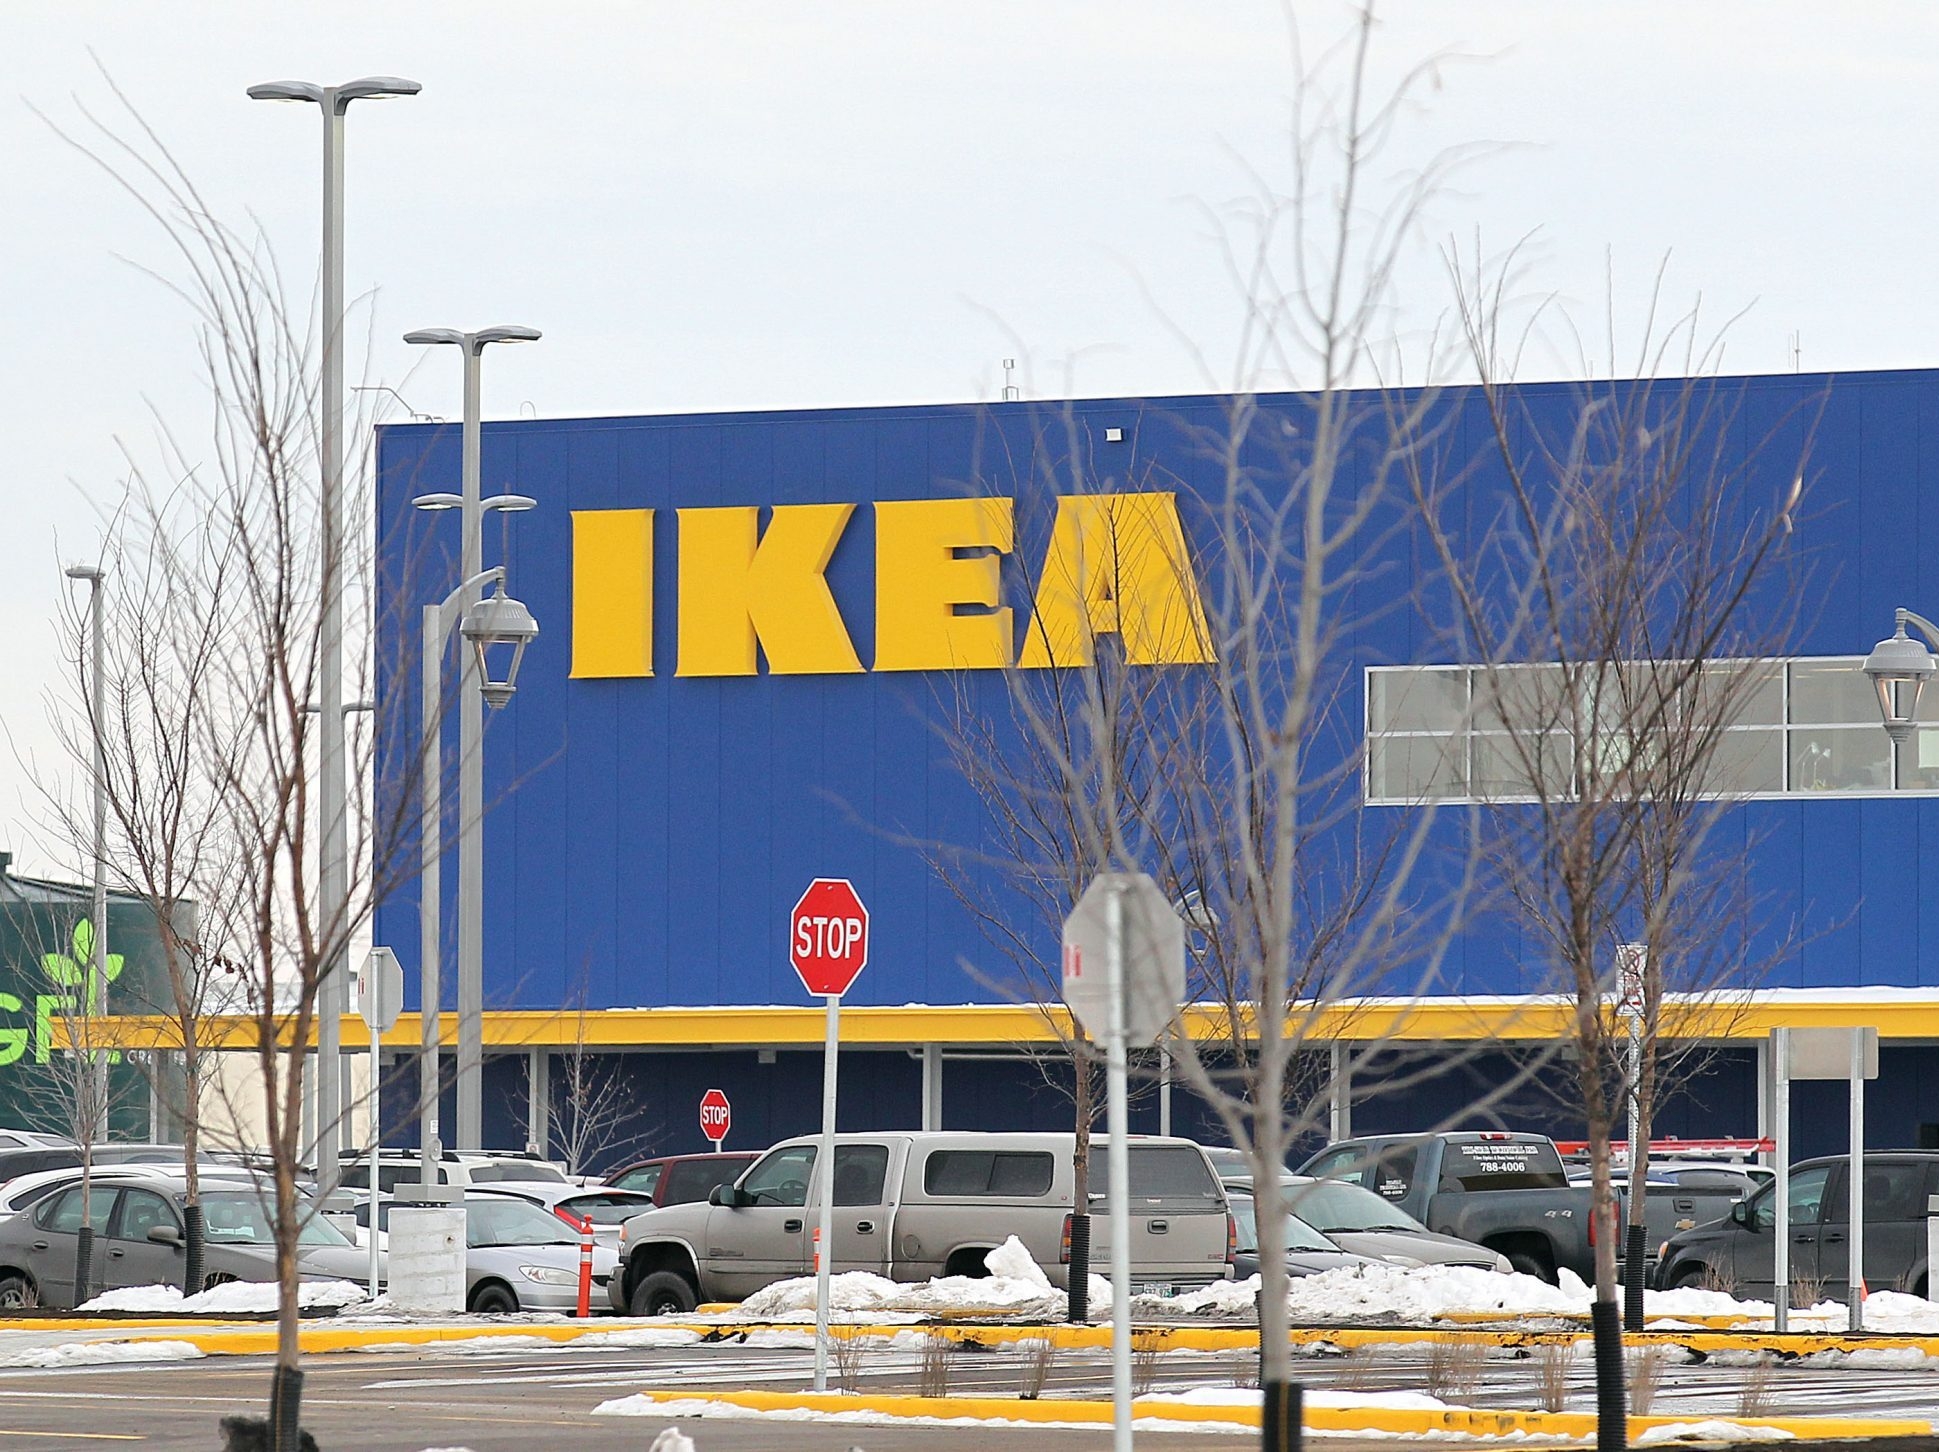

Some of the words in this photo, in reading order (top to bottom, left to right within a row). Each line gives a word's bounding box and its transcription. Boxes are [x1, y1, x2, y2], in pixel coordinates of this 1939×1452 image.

[568, 491, 1219, 679] IKEA
[796, 916, 862, 959] STOP
[702, 1105, 728, 1125] STOP
[1480, 1162, 1525, 1172] 788-4006
